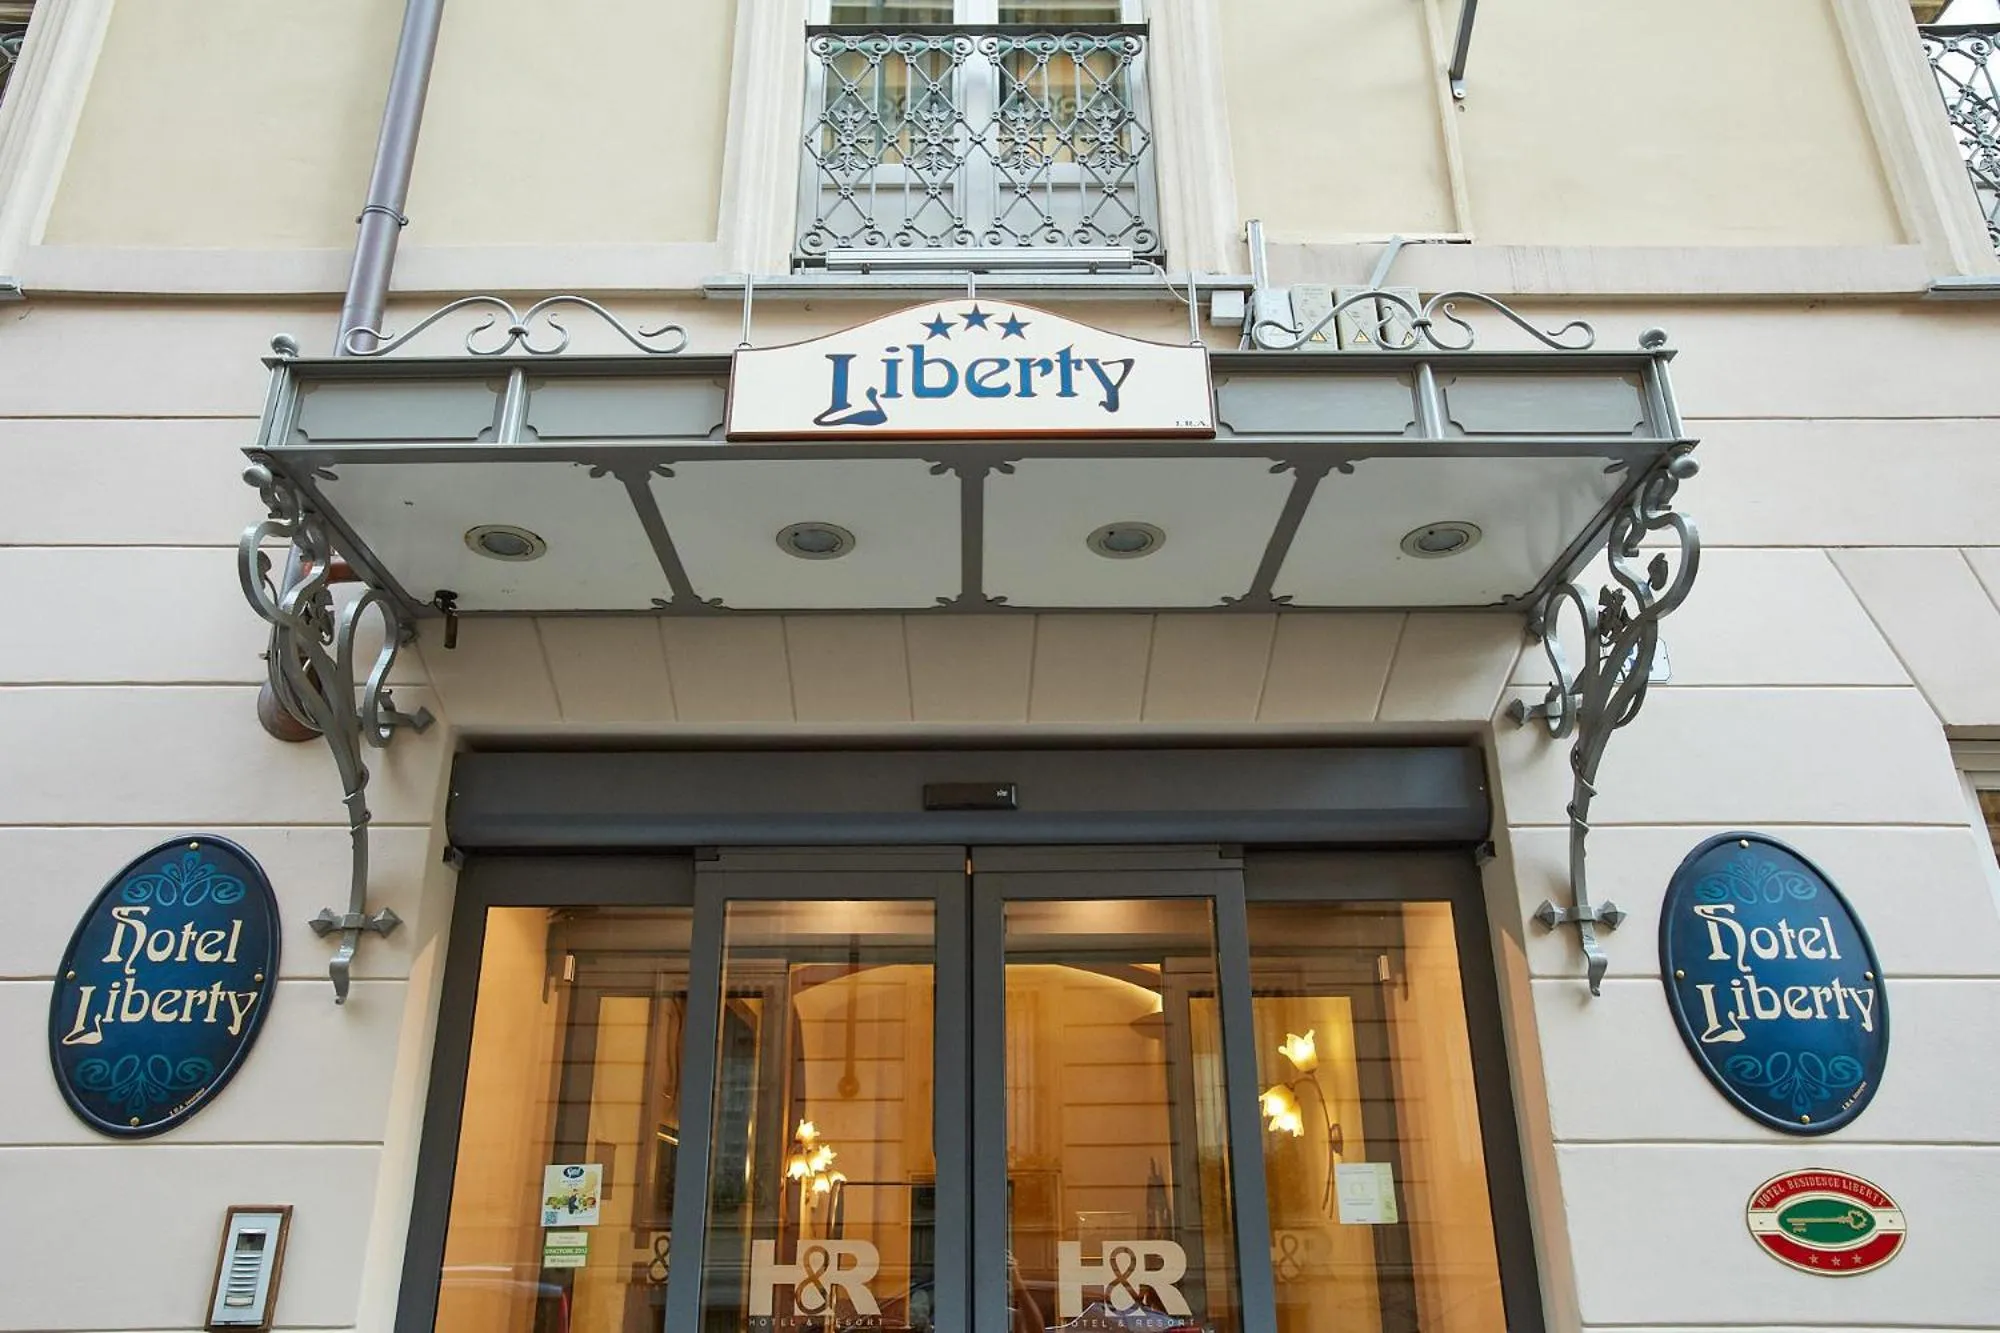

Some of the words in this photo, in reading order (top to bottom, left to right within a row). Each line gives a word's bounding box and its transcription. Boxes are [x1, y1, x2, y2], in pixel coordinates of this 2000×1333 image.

[813, 343, 1135, 426] Liberty
[102, 905, 243, 975] Hotel
[1693, 903, 1842, 973] Hotel
[62, 977, 258, 1045] Liberty
[1695, 975, 1875, 1043] Liberty
[1758, 1183, 1785, 1207] HOTEL
[1787, 1176, 1840, 1190] RESIDENCE
[1841, 1179, 1887, 1206] LIBERTY
[749, 1239, 881, 1316] H&R
[1058, 1240, 1192, 1317] H&R
